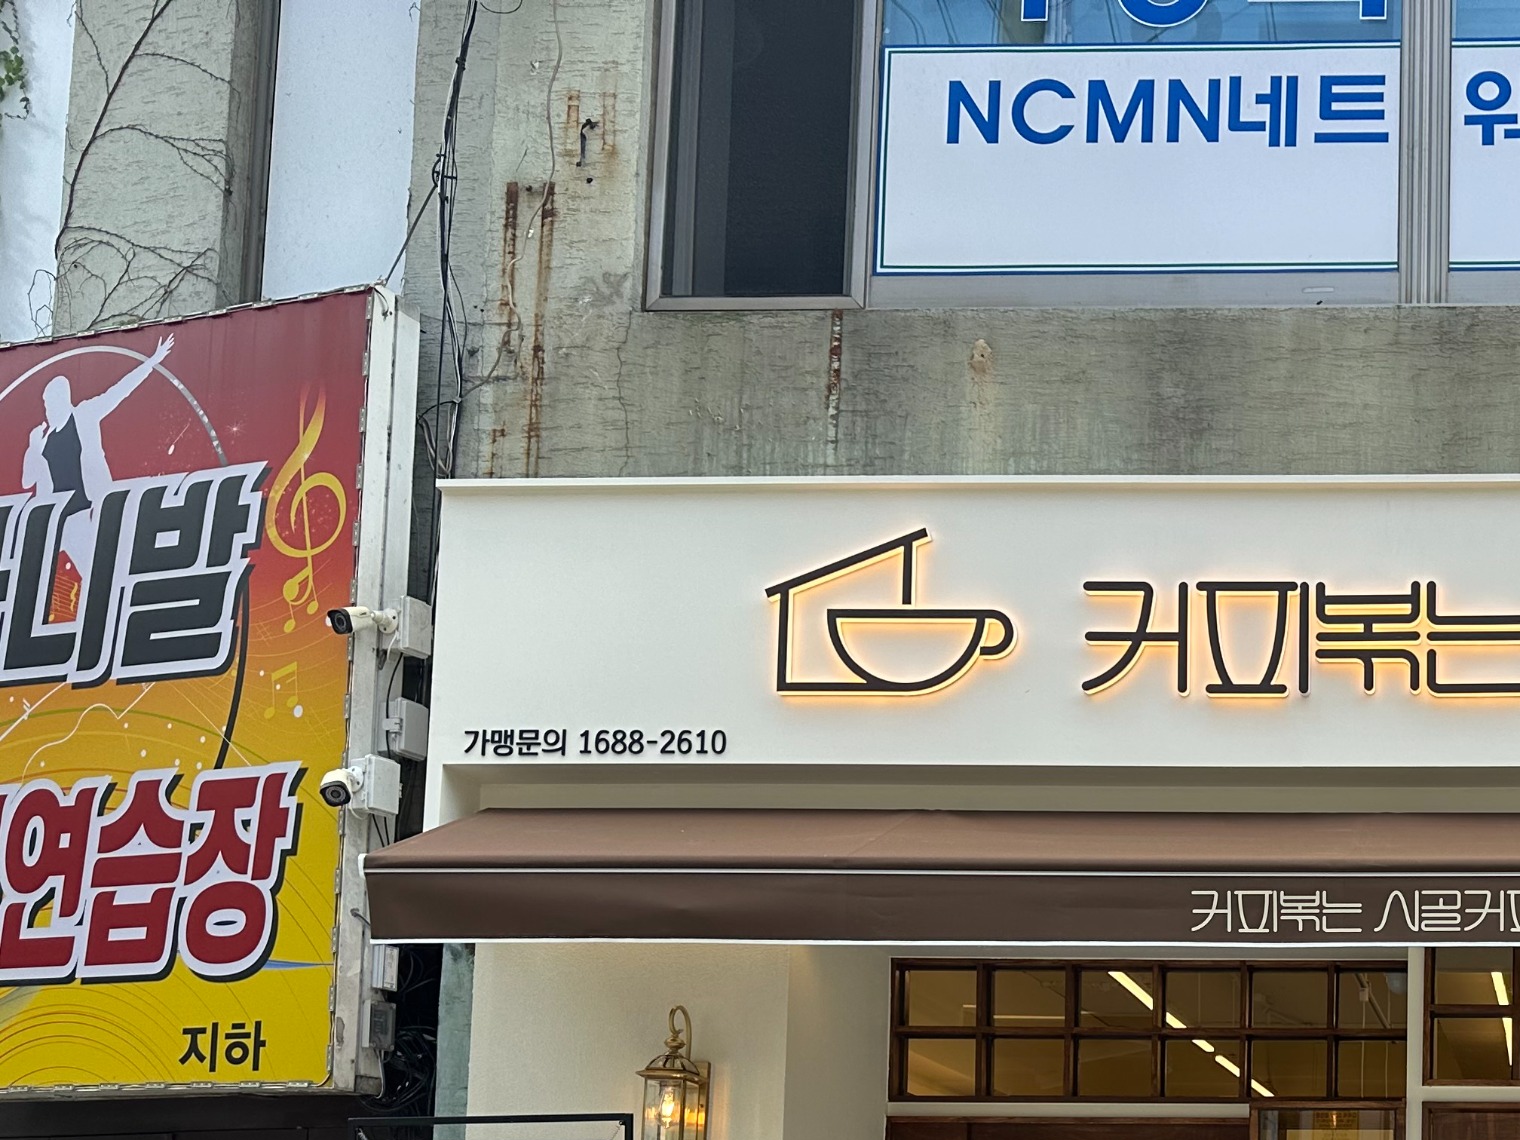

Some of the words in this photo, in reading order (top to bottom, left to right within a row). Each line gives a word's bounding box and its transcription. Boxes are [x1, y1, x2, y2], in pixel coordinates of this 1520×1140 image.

[0, 466, 266, 682] 니발
[463, 728, 568, 758] 가맹문의
[578, 729, 727, 756] 1688-2610
[0, 765, 300, 978] 연습장
[1191, 890, 1363, 933] 커피볶는
[179, 1020, 267, 1073] 지하
